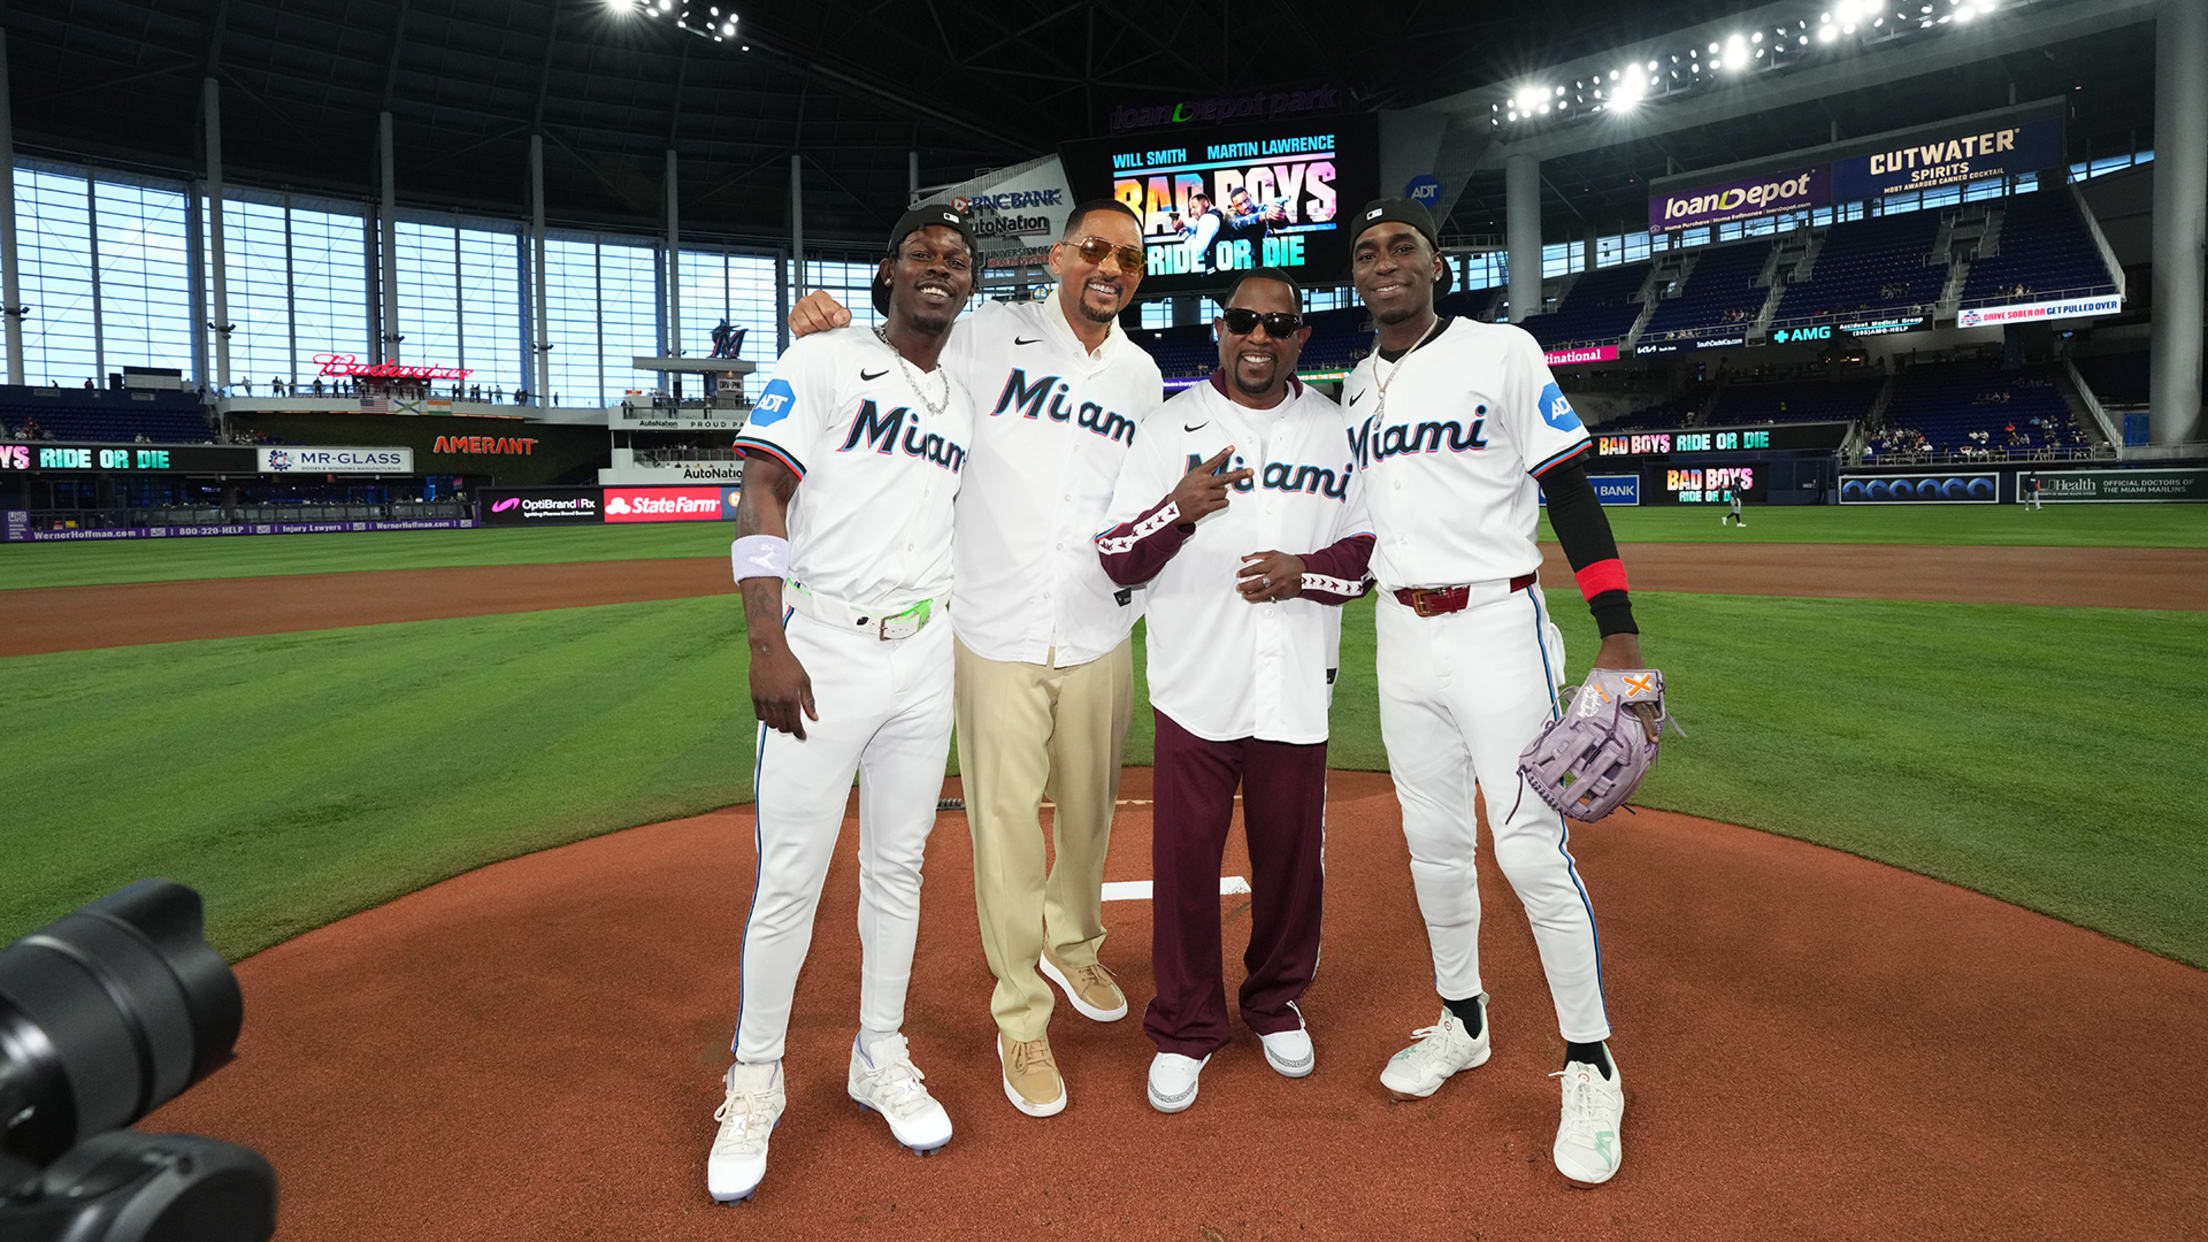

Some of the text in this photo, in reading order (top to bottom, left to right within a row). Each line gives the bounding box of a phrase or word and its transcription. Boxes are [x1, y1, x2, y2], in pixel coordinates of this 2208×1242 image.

[1269, 83, 1338, 119] park
[1112, 134, 1335, 168] WILL SMITH MARTIN LAWRENCE
[1870, 128, 2015, 176] CUTWATER
[1884, 168, 2005, 194] MOST AWARDED CANNED COCKTAIL
[1911, 161, 1970, 183] SPIRITS
[1114, 161, 1337, 235] BAD BOYS
[1410, 184, 1438, 199] ADT
[1665, 172, 1811, 220] loanDepot
[970, 214, 1048, 232] utoNation
[1682, 219, 1710, 230] Purchase
[1020, 255, 1050, 266] SYSTE
[1147, 235, 1305, 276] RIDE OR DIE
[1983, 311, 2006, 322] DRIVE
[2007, 309, 2033, 320] SOBER
[2034, 307, 2046, 316] OR
[2047, 306, 2062, 315] GET
[2063, 303, 2094, 314] PULLED
[2095, 300, 2118, 311] OVER
[1791, 326, 1831, 342] AMG
[312, 353, 475, 380] Budweiser
[1544, 348, 1601, 365] tinational
[756, 392, 788, 413] ADT
[989, 367, 1136, 449] Miam
[1550, 395, 1573, 421] AD
[639, 419, 678, 428] AutoNation
[433, 435, 536, 455] AMERANT
[835, 398, 967, 475] Miam
[1346, 404, 1489, 471] Miami
[1599, 431, 1769, 456] BAD BOYS RIDE OR DIE
[39, 448, 92, 468] RIDE
[99, 449, 129, 469] OR
[137, 450, 170, 469] DIE
[301, 453, 401, 464] MR-GLASS
[684, 468, 743, 479] AutoNatio
[1667, 467, 1753, 491] BAD BOYS
[2141, 479, 2186, 487] DOCTORS
[1600, 485, 1635, 497] BANK
[1679, 491, 1702, 502] RIDE
[1705, 490, 1719, 502] OR
[522, 498, 596, 511] OptiBrand Rx
[34, 527, 136, 540] WernerHoffman.com
[179, 526, 244, 536] 800-320-HELP
[282, 522, 307, 534] Injury
[309, 523, 342, 532] Lawyers
[376, 520, 450, 530] WernerHoffman.com
